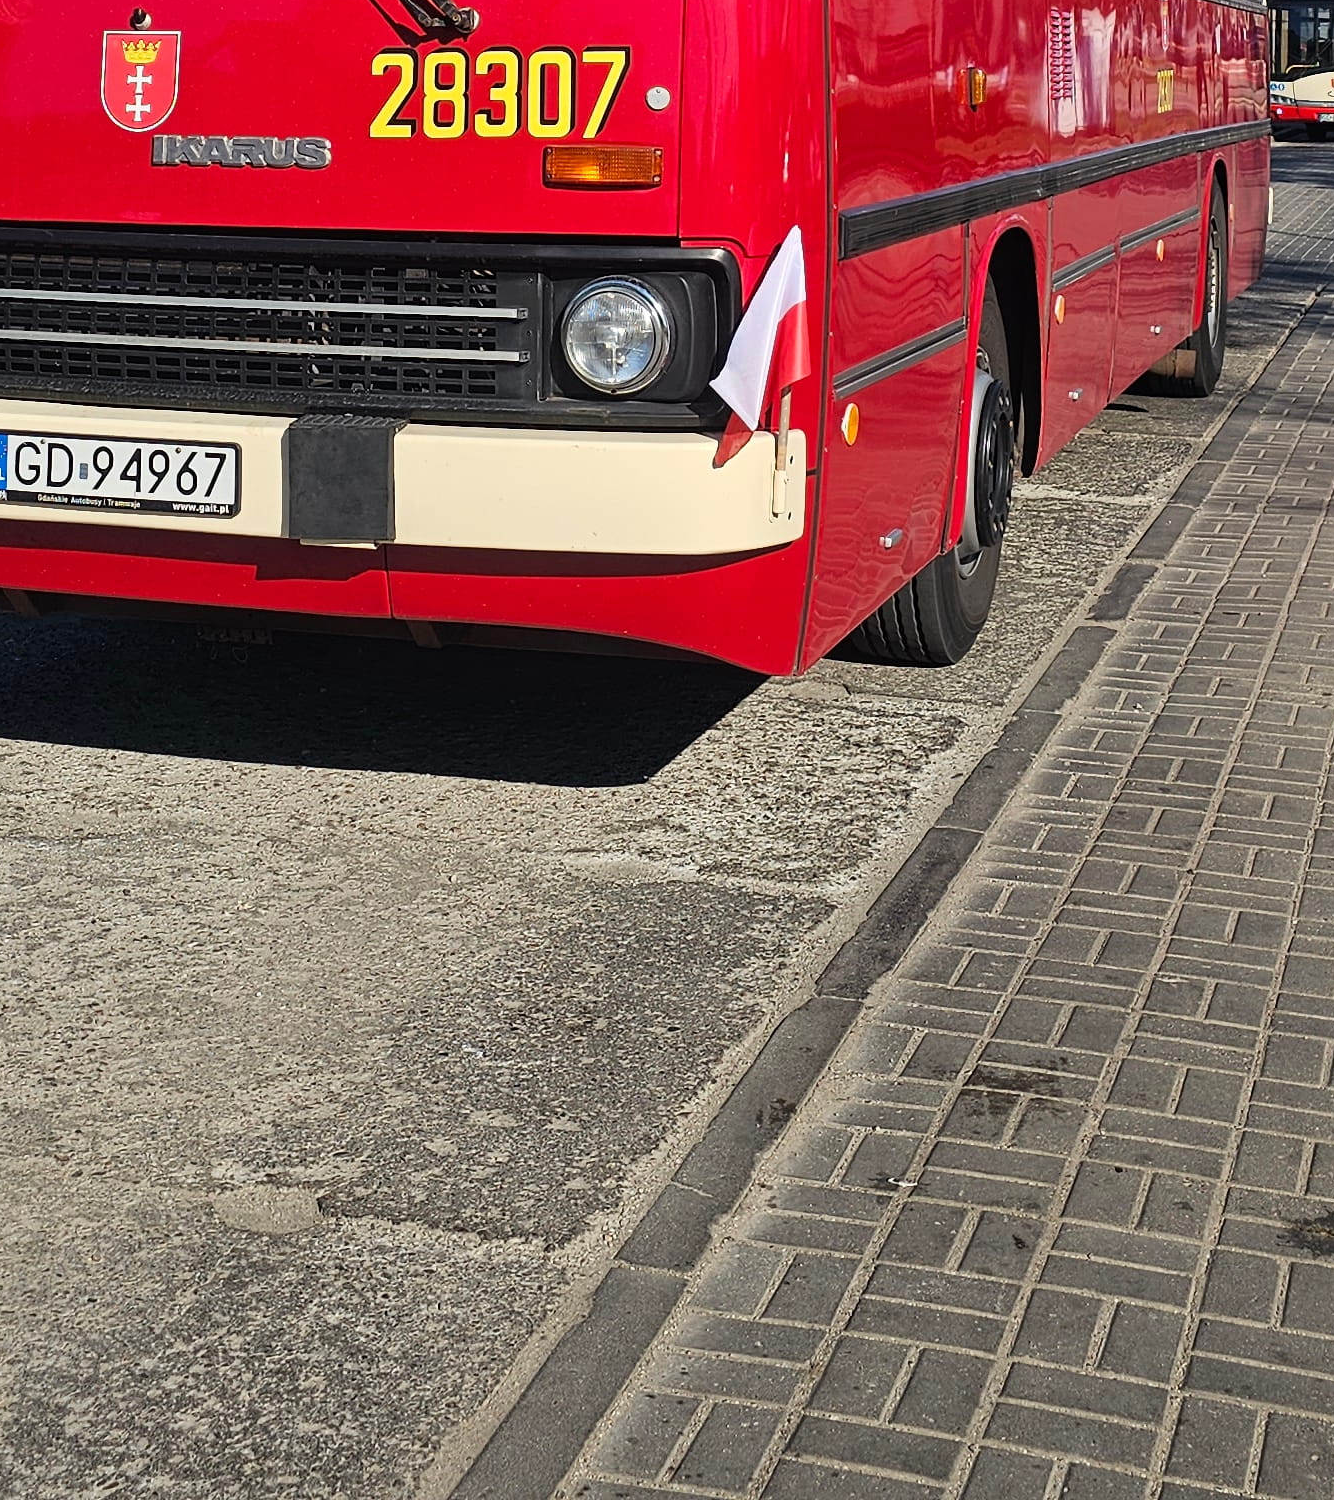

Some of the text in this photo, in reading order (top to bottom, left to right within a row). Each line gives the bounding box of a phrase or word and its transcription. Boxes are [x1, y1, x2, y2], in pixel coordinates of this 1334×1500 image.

[369, 46, 630, 139] 28307
[151, 134, 333, 169] IKARUS
[14, 441, 227, 498] GD 94967
[71, 496, 102, 507] Autobusy
[172, 503, 230, 515] www.gait.pl
